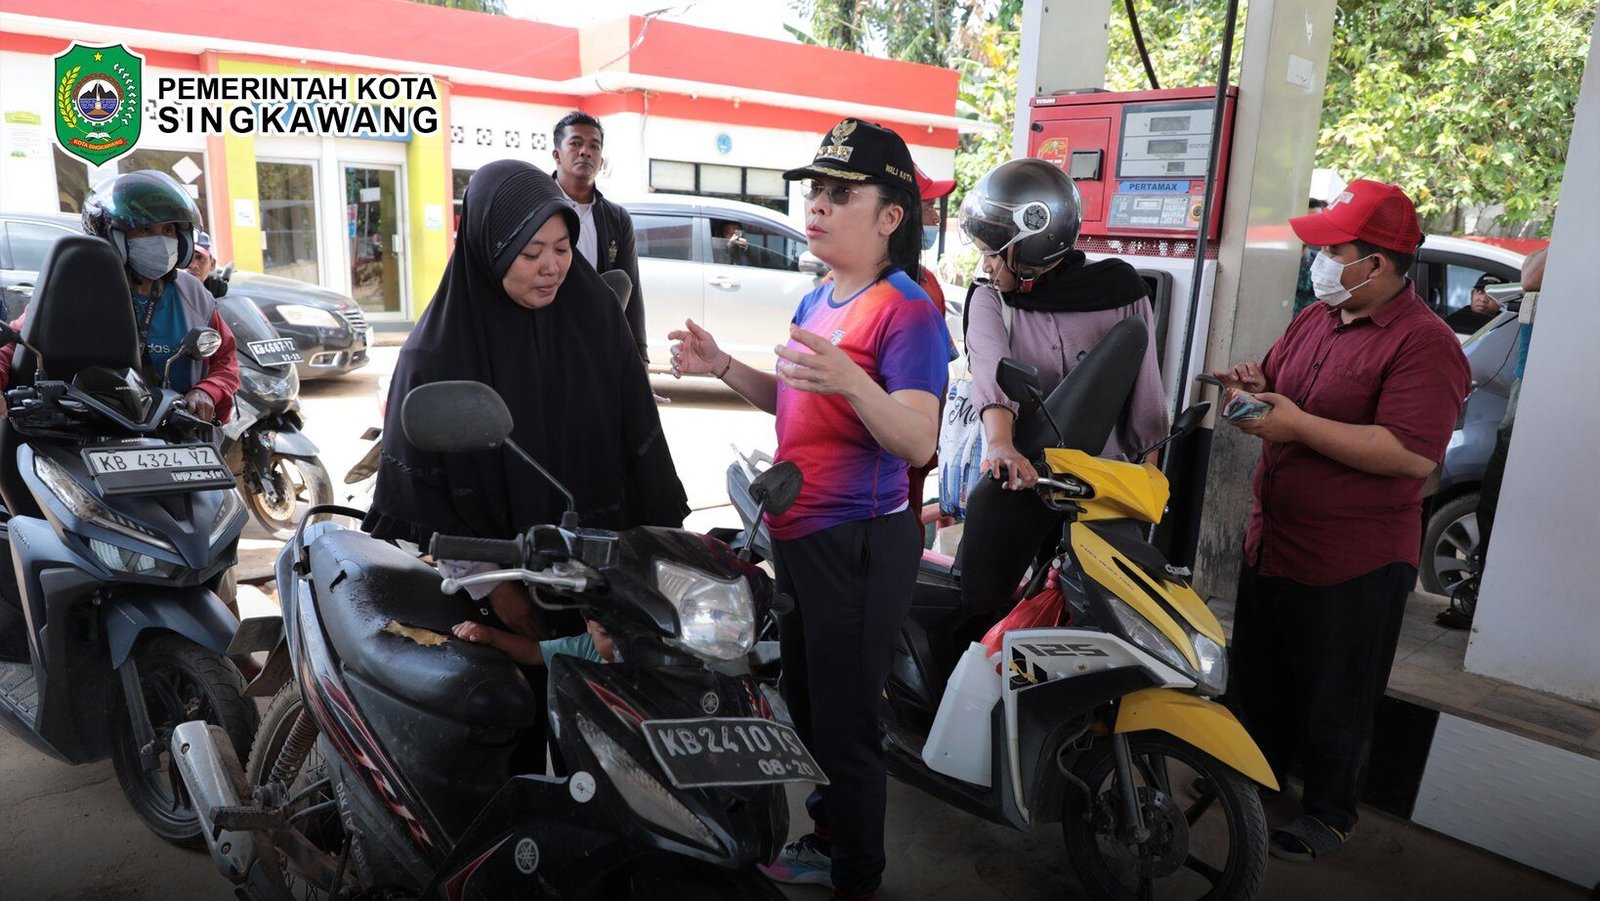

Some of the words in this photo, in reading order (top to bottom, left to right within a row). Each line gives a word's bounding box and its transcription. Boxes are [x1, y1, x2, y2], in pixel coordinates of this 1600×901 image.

[885, 164, 899, 176] WALI
[899, 169, 913, 183] KOTA
[1129, 182, 1178, 192] PERTAMAX
[99, 455, 127, 471] KB
[138, 452, 182, 468] 4324
[188, 450, 213, 465] YZ
[1019, 643, 1110, 657] 125
[658, 728, 702, 757] KB
[698, 725, 772, 753] 2410
[766, 725, 802, 756] YS
[335, 781, 349, 809] DAK
